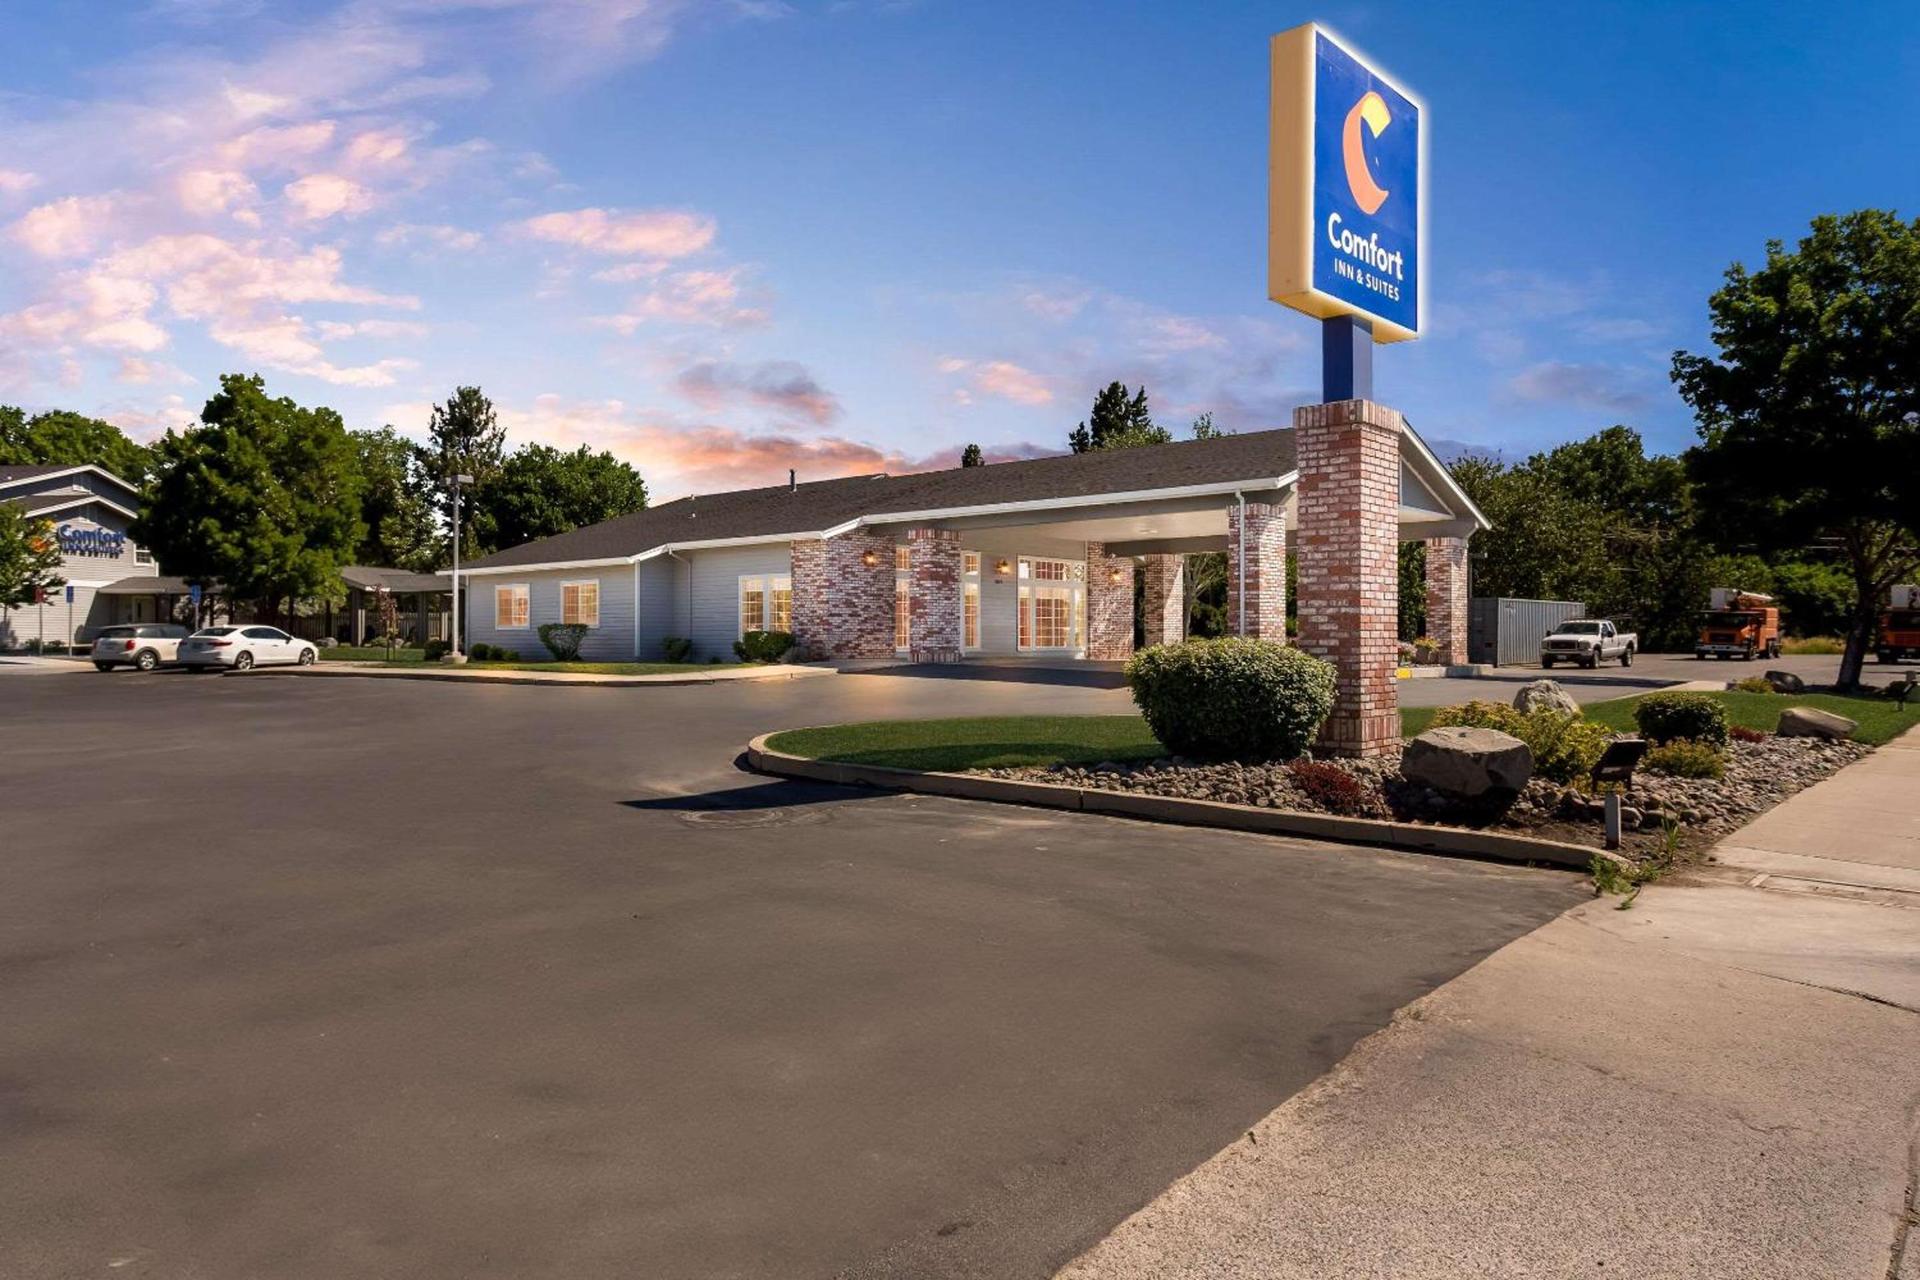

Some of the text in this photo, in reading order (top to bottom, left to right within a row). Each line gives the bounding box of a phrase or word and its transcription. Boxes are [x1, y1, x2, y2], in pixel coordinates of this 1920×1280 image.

[1328, 212, 1403, 281] Comfort
[1334, 257, 1400, 302] INN & SUITES
[59, 524, 125, 543] Comfort
